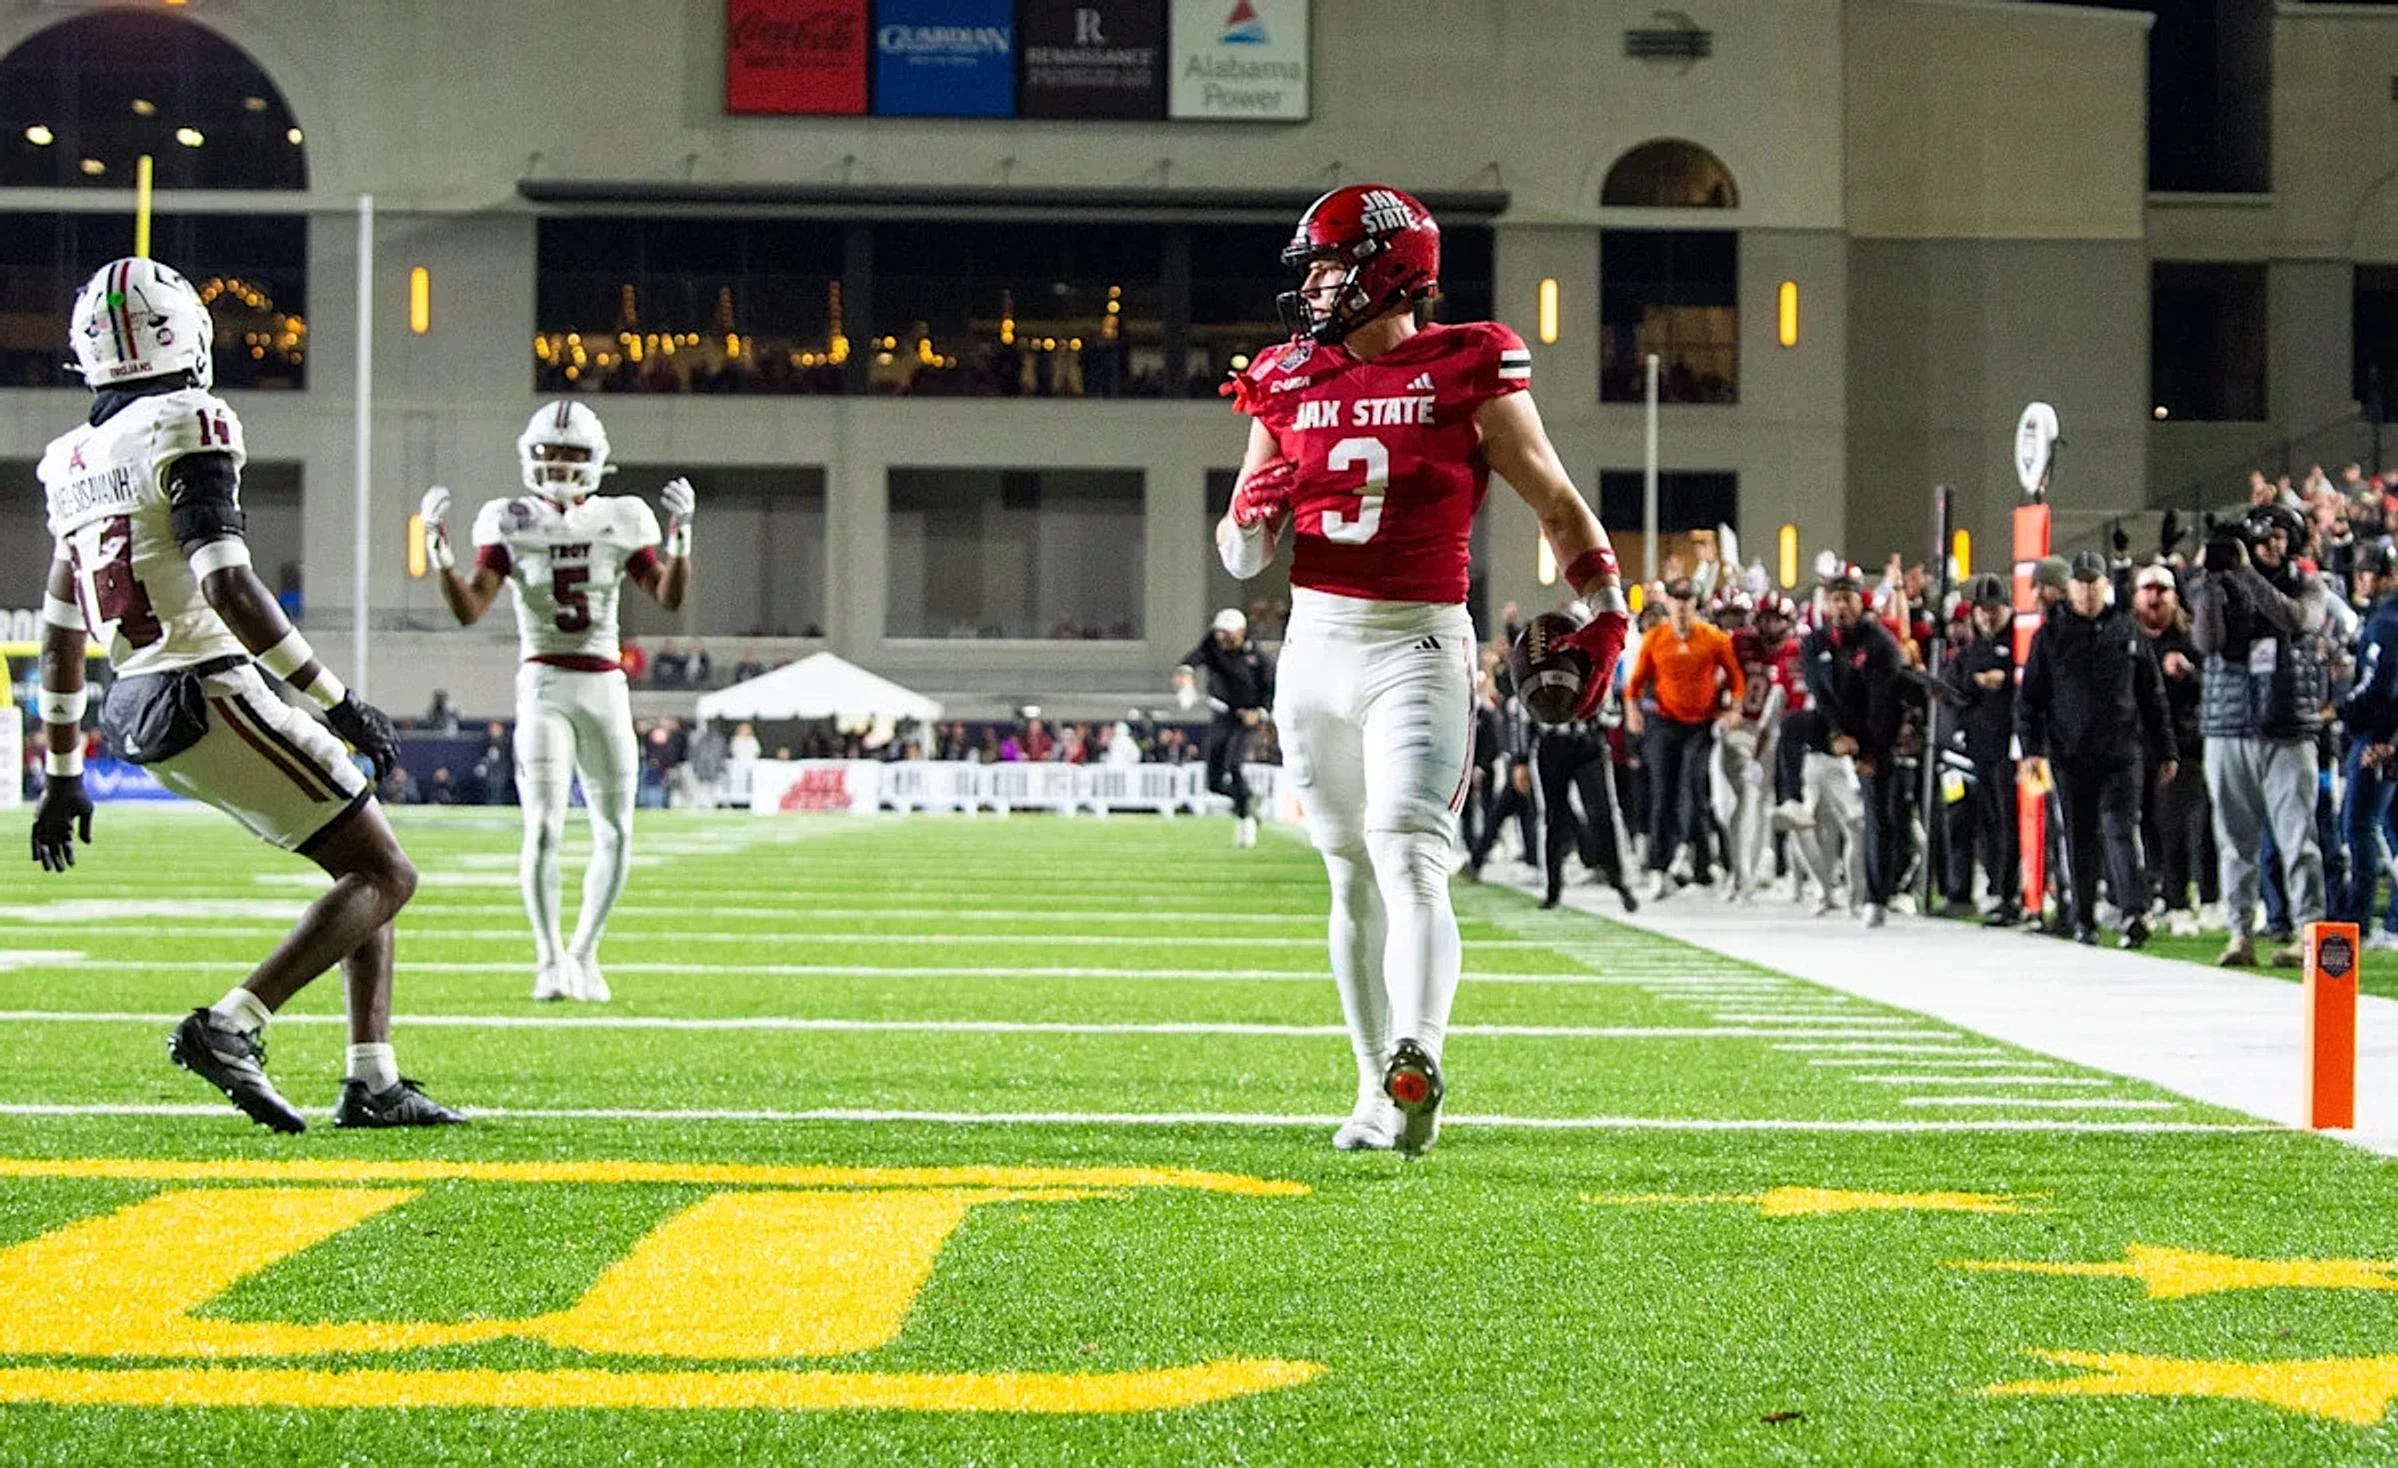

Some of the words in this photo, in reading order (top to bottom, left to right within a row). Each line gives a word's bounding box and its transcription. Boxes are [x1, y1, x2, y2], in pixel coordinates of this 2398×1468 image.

[1074, 7, 1105, 45] R
[1183, 54, 1302, 79] Alabama
[1203, 82, 1283, 110] Power
[1360, 189, 1403, 212] JAX
[1360, 204, 1422, 234] STATE
[109, 362, 153, 378] TROJANS
[1291, 399, 1341, 432] JAX
[1351, 394, 1437, 427] STATE
[1321, 436, 1389, 545] 3
[549, 542, 593, 559] TROY
[553, 566, 592, 632] 5
